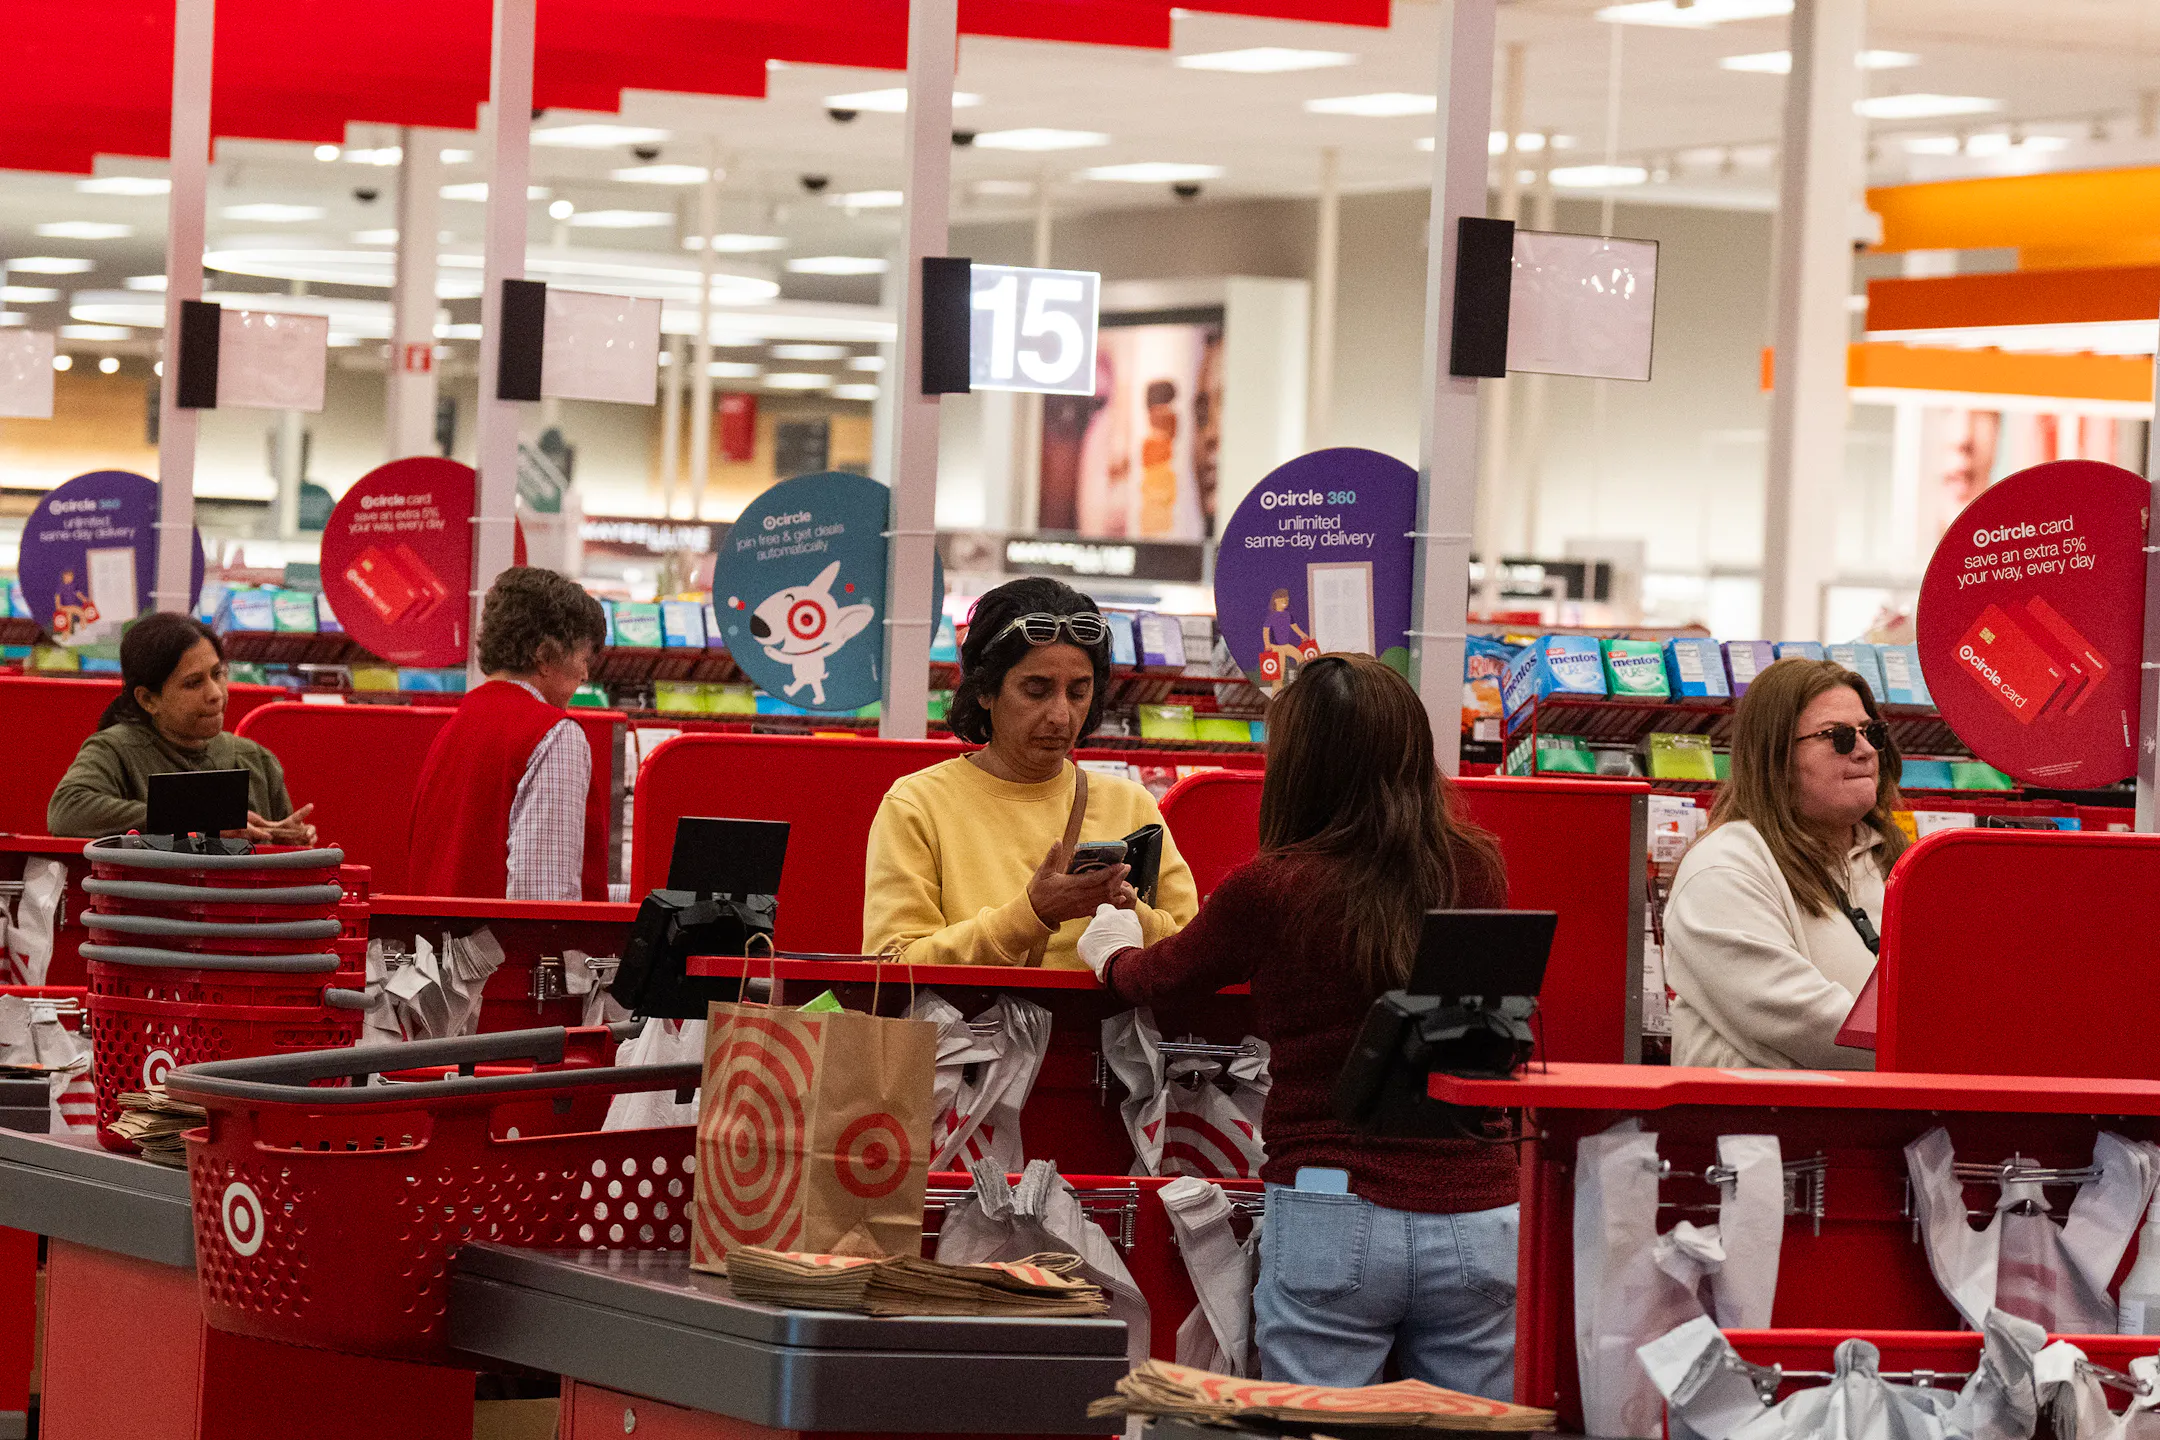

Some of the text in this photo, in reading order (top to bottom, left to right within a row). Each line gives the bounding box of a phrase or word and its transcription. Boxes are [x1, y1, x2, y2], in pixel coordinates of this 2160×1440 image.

[973, 276, 1084, 384] 15
[61, 498, 97, 513] circle
[372, 492, 432, 508] circle card
[1278, 489, 1356, 506] circle 360
[353, 511, 379, 522] save
[379, 510, 394, 521] an
[776, 510, 812, 527] circle
[1278, 513, 1341, 531] unlimited
[736, 523, 845, 552] join free & get deals
[1990, 515, 2074, 543] circle card
[1244, 530, 1375, 550] same-day delivery
[756, 540, 829, 561] automatically
[1964, 553, 1998, 570] save
[2001, 549, 2020, 564] an
[2023, 543, 2060, 560] extra
[1957, 553, 2096, 590] your way, every day
[1549, 653, 1598, 665] mentos
[1612, 656, 1660, 667] mentos
[1970, 654, 2028, 709] circle card
